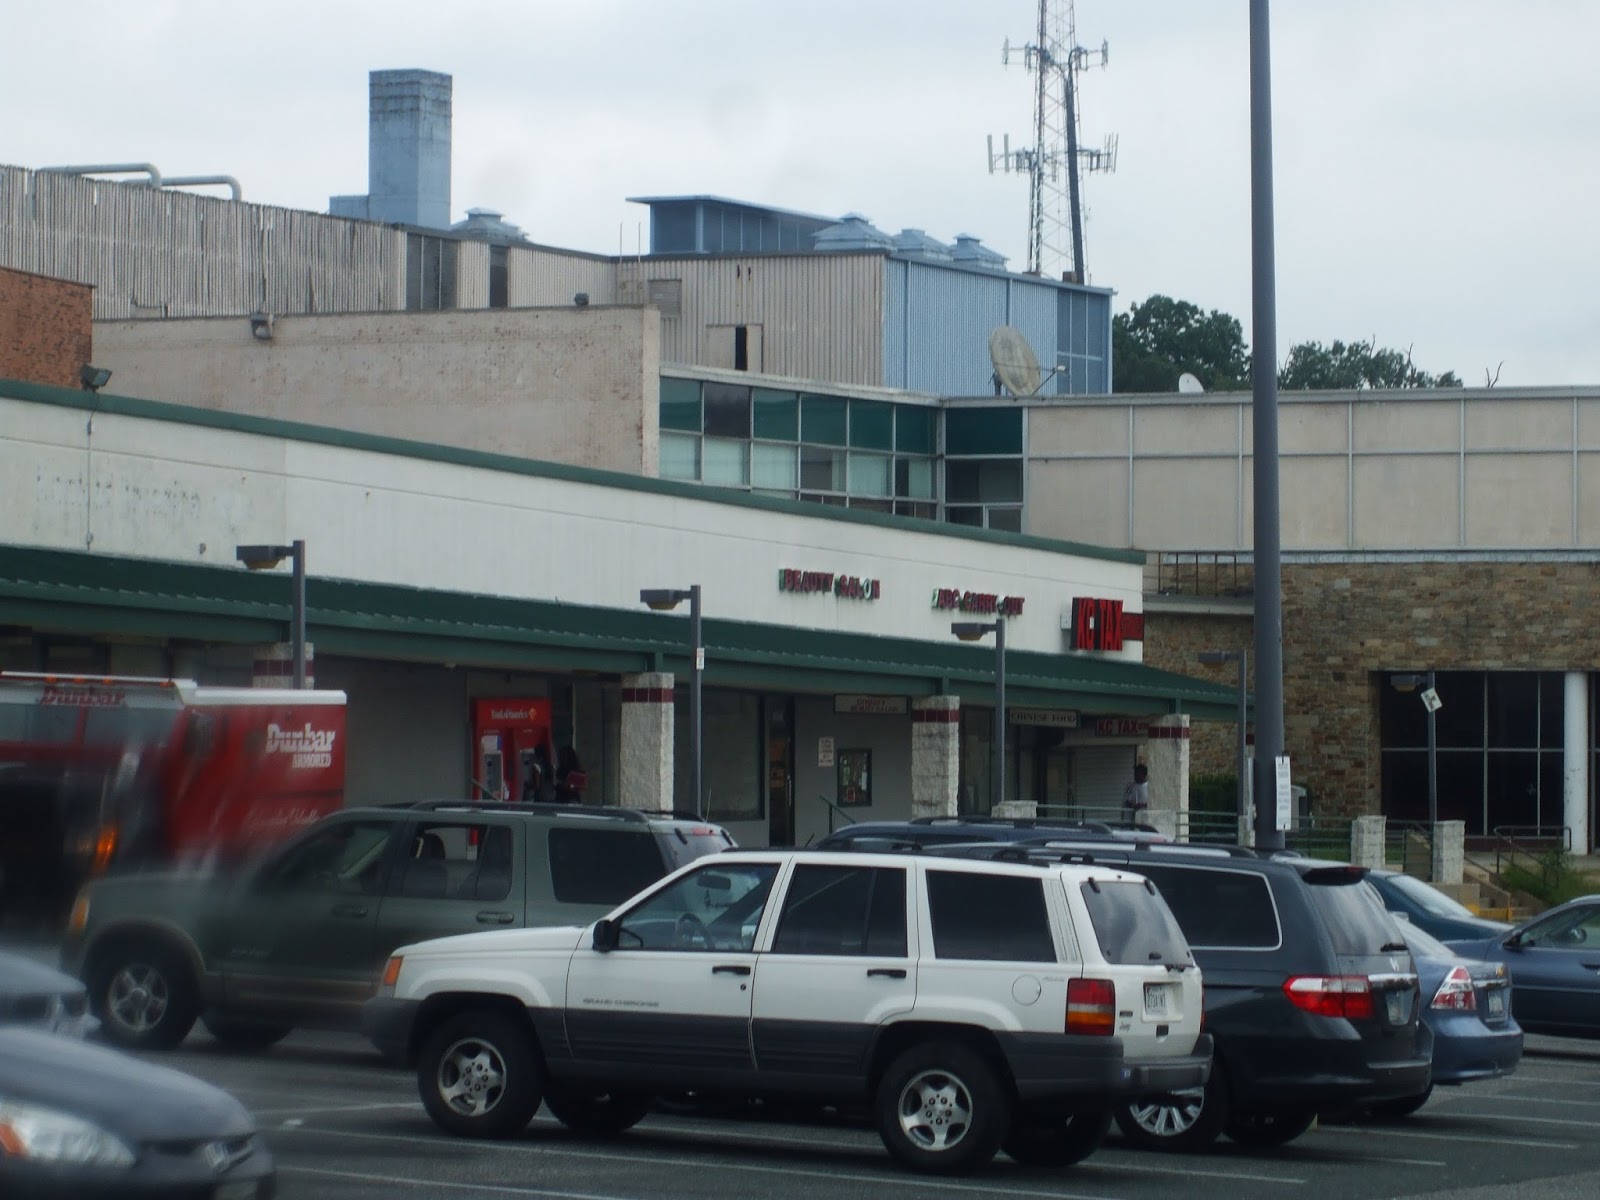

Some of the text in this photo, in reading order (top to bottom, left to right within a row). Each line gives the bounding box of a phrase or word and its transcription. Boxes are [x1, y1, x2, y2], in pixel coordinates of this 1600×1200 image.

[780, 569, 881, 601] BEAUTY SALON
[1098, 598, 1123, 652] TAX
[265, 722, 336, 753] Dunbar
[292, 753, 332, 769] ARMORED
